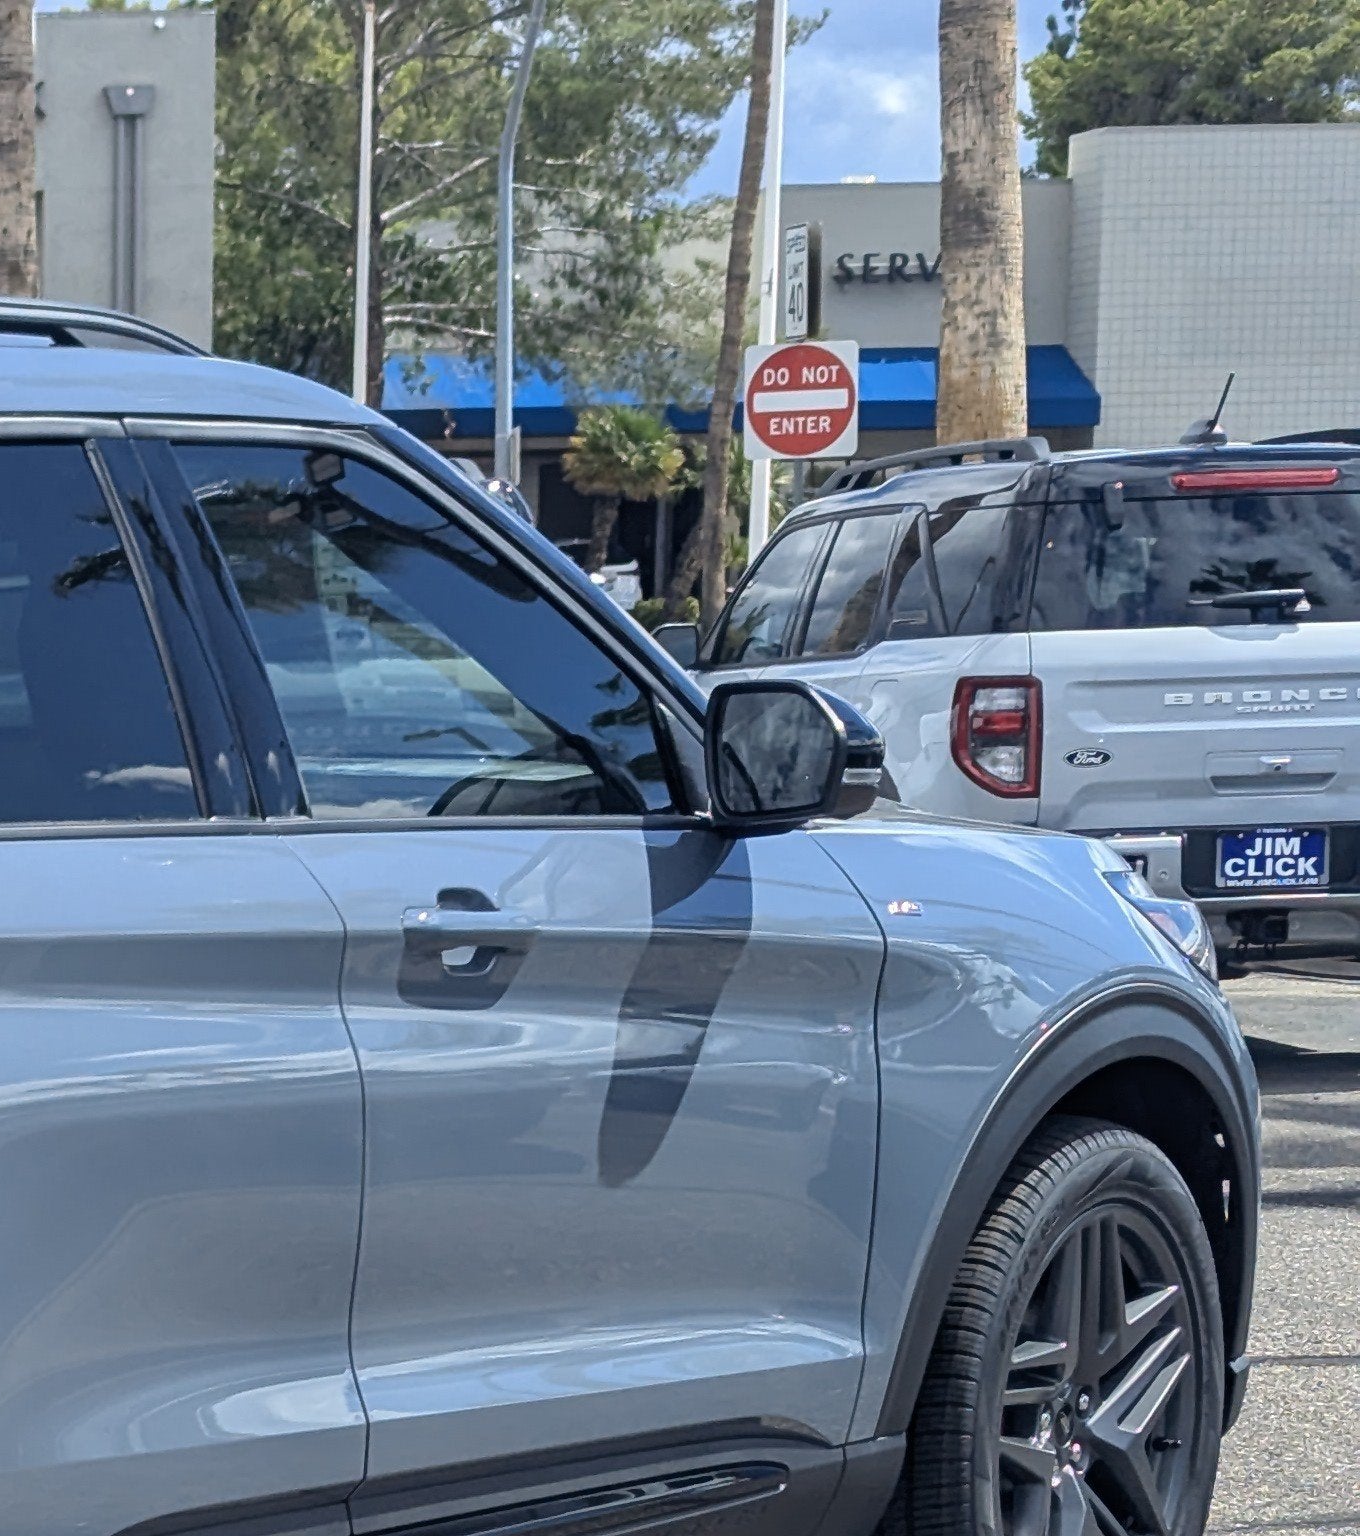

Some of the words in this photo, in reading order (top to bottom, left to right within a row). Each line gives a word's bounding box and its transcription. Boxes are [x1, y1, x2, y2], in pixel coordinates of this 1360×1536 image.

[833, 252, 943, 285] SERV
[763, 367, 790, 387] DO
[801, 364, 840, 385] NOT
[769, 415, 832, 436] ENTER
[1164, 688, 1360, 706] BRONC
[1244, 836, 1302, 857] JIM
[1224, 856, 1319, 877] CLICK
